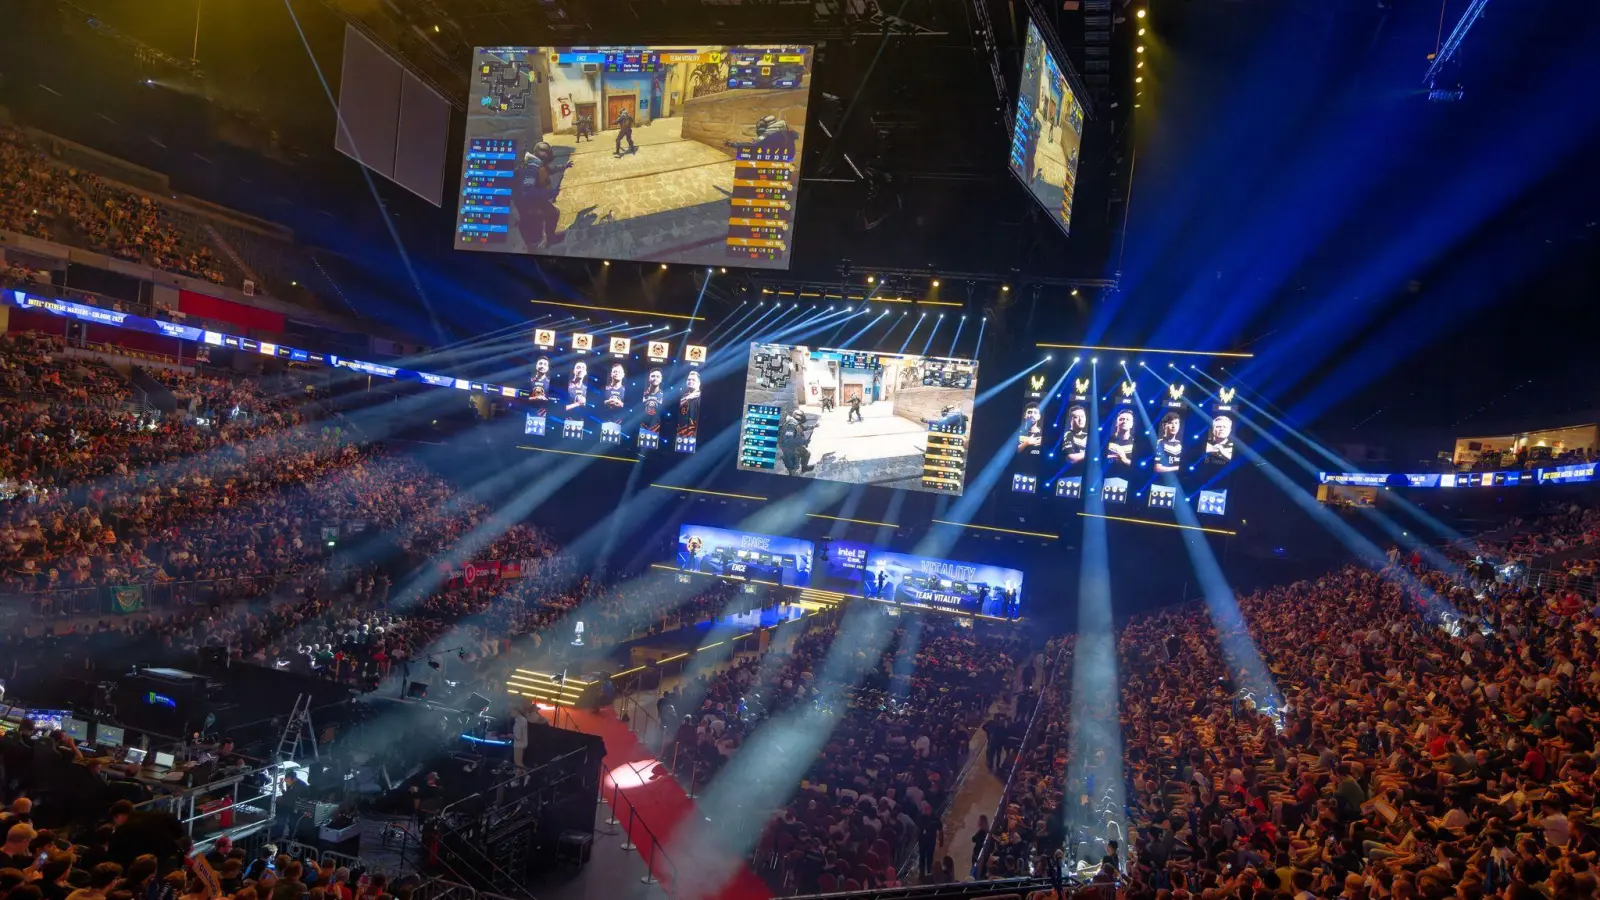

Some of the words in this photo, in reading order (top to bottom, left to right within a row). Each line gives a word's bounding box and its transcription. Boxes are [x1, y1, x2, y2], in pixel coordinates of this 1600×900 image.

[561, 103, 572, 119] B
[44, 302, 67, 312] EXTREME
[67, 307, 88, 316] MASTERS
[92, 311, 111, 321] COLOGNE
[838, 547, 856, 558] intel
[731, 563, 747, 572] ENCE
[921, 560, 977, 582] VITALITY
[915, 591, 933, 600] TEAM
[934, 593, 961, 604] VITALITY
